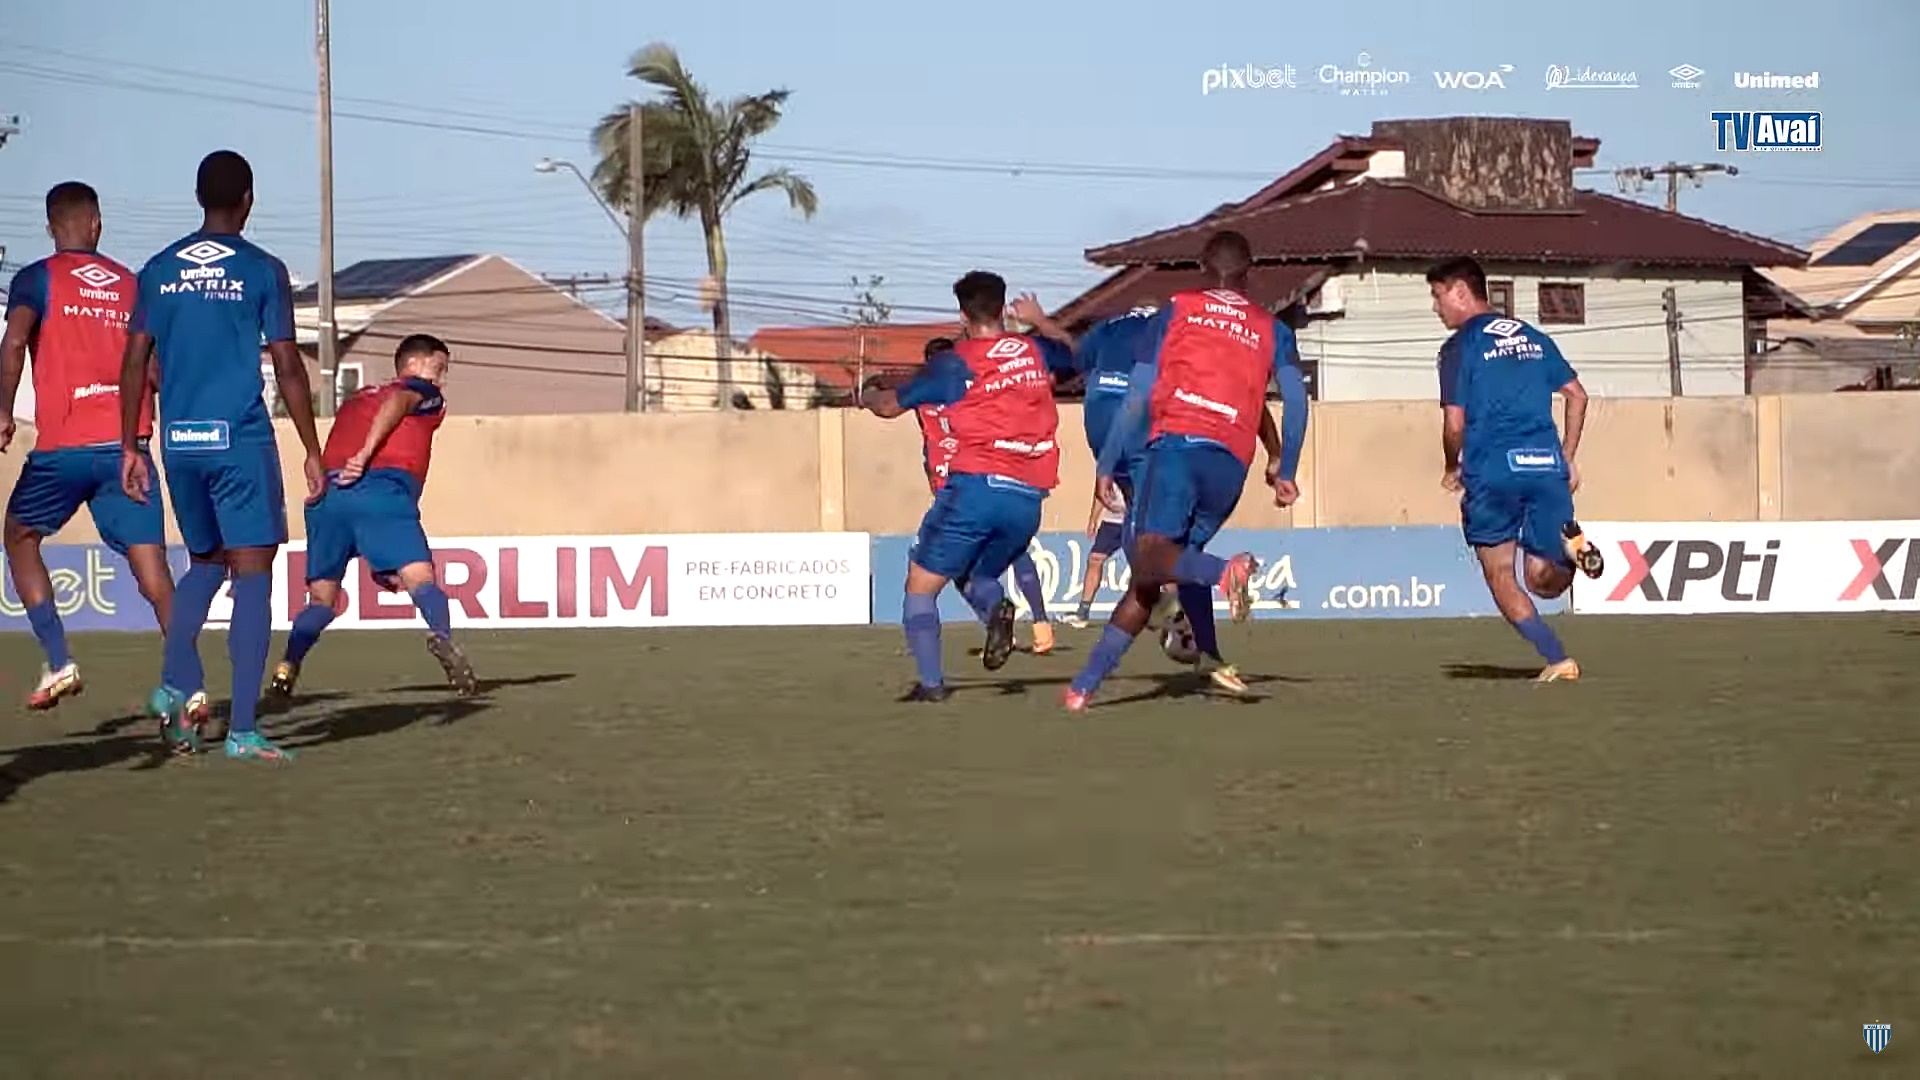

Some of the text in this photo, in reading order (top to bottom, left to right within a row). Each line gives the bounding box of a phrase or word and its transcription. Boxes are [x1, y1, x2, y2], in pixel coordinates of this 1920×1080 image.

[180, 265, 226, 279] umbro
[79, 287, 120, 301] umbro
[160, 280, 244, 295] MATRIX
[1205, 302, 1247, 320] umbro
[1187, 316, 1261, 343] MATRIX
[1484, 343, 1543, 361] MATRIX
[997, 357, 1035, 374] umbro
[171, 429, 220, 442] Unimed
[1605, 540, 1781, 602] XPti
[699, 584, 837, 601] EM CONCRETO
[1321, 576, 1446, 608] .com.br
